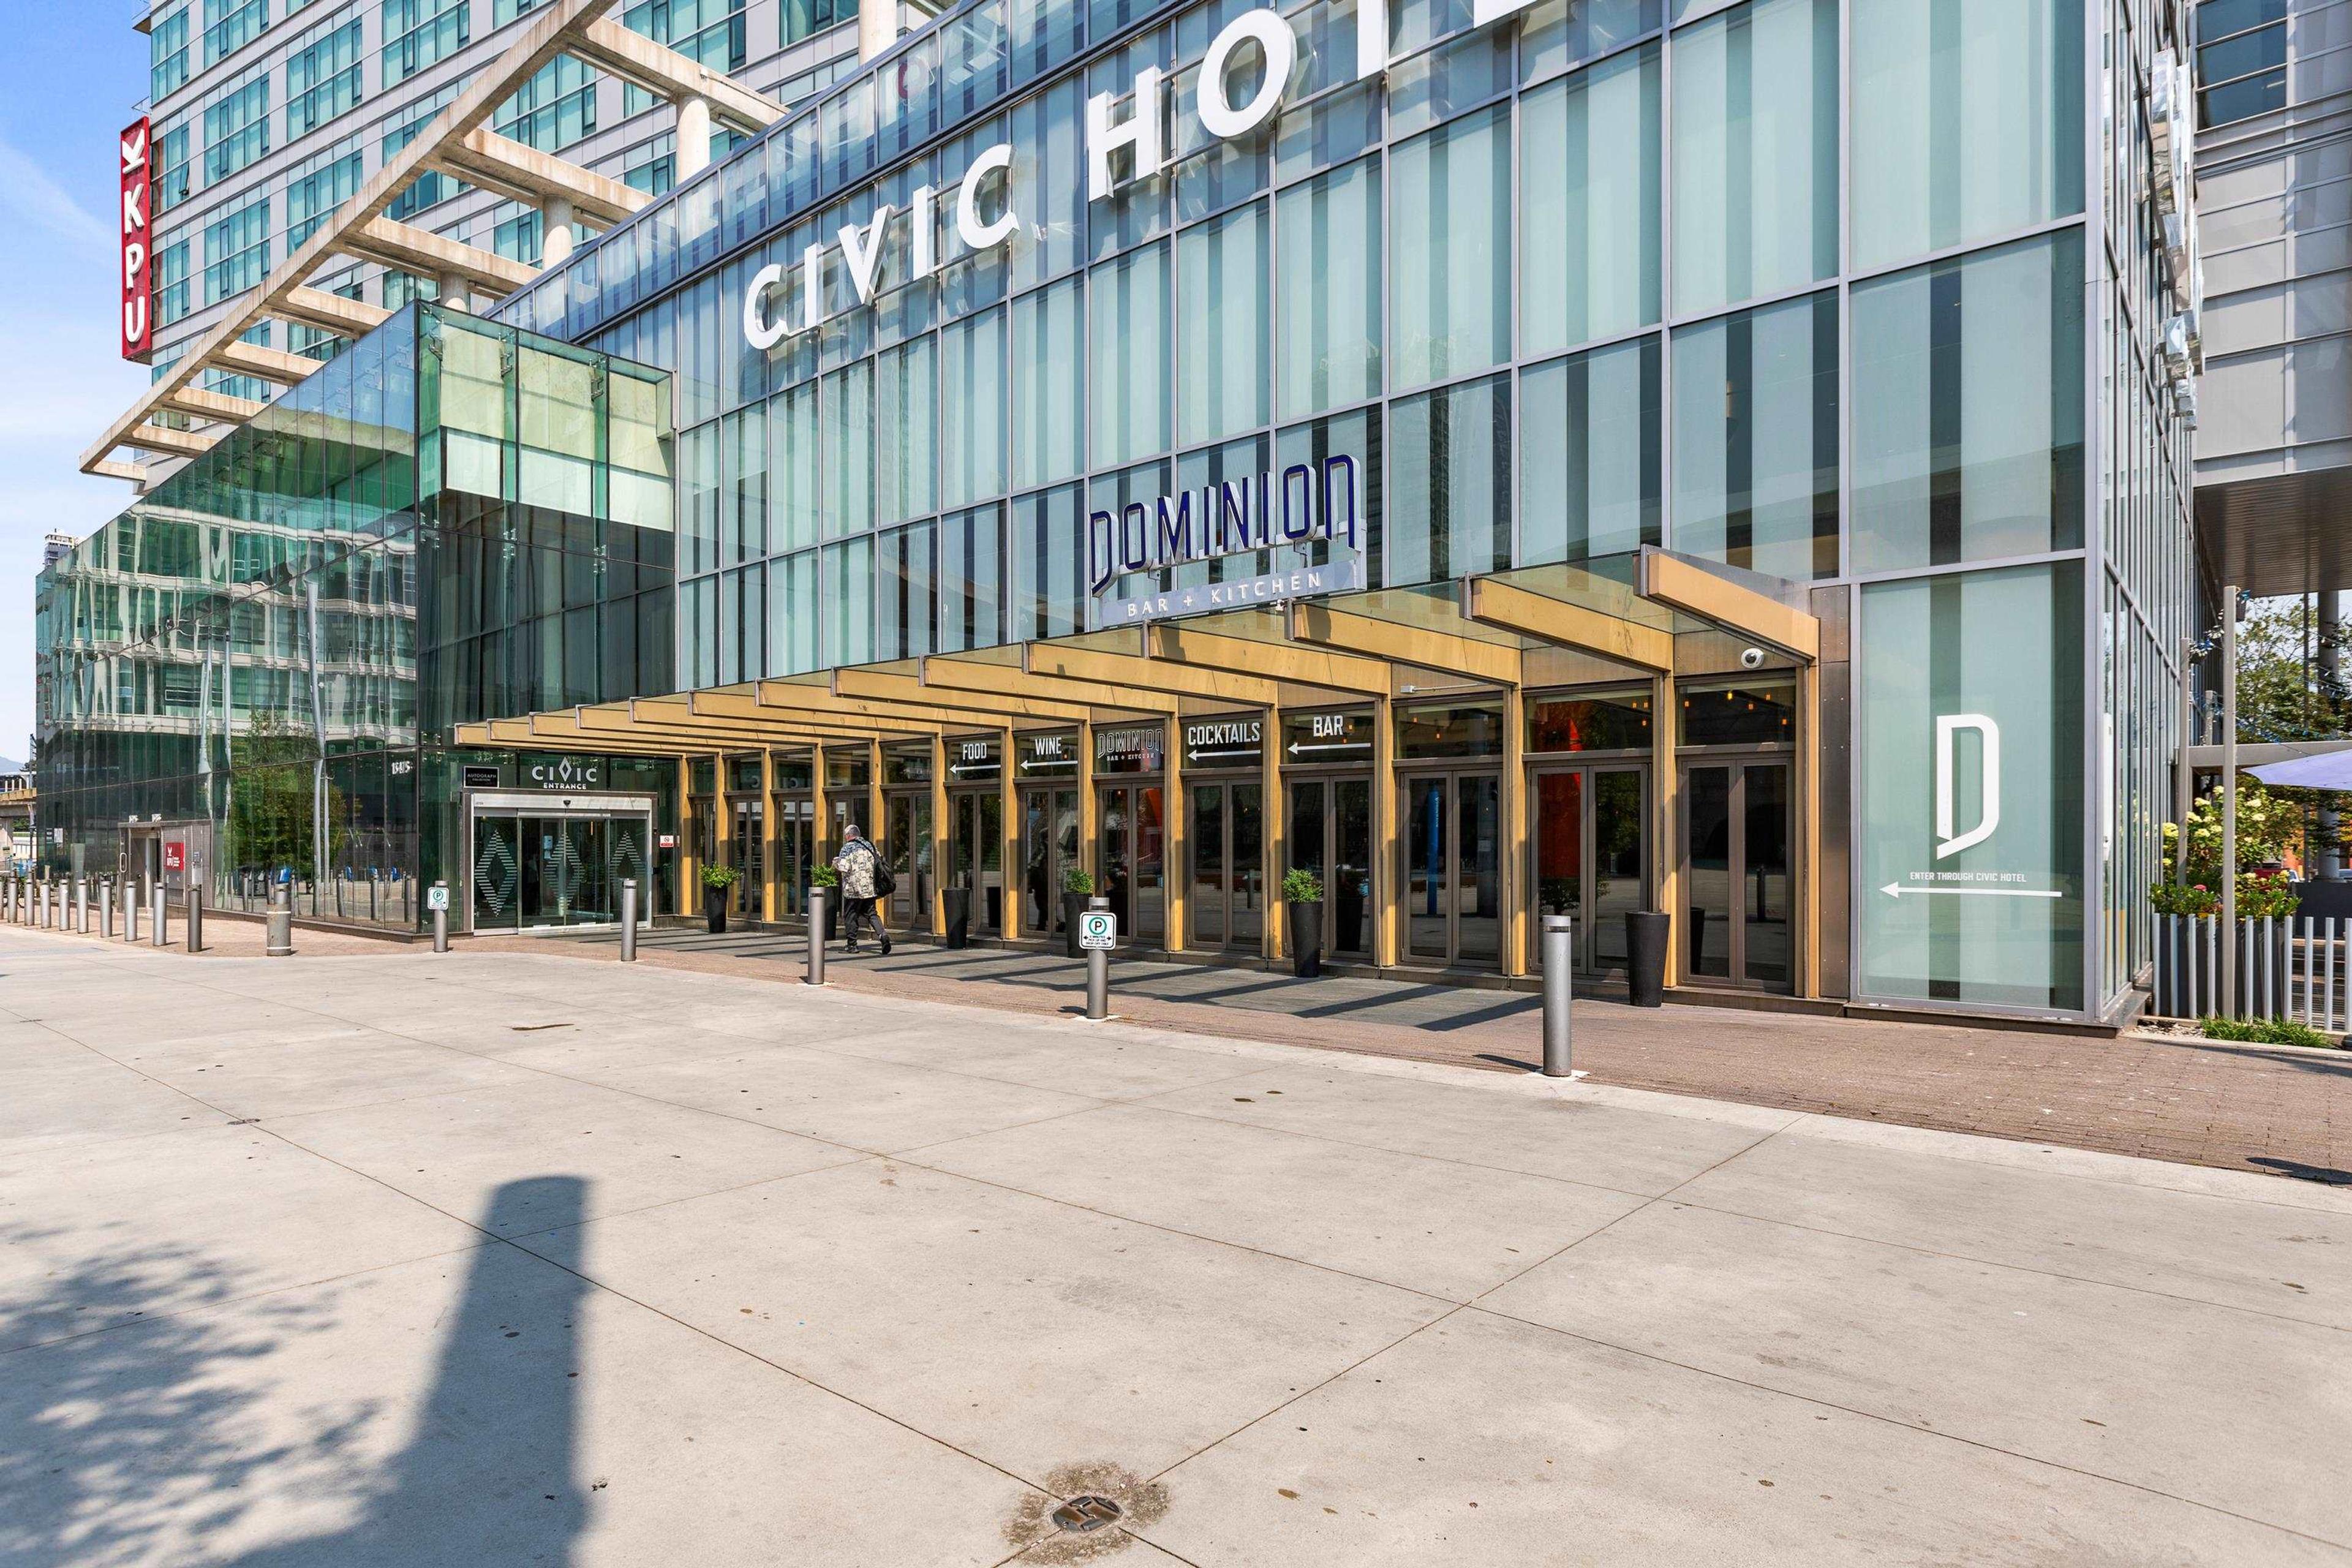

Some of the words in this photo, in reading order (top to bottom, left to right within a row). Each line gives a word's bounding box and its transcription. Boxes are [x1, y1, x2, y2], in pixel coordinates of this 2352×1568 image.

[744, 143, 1019, 351] CIVIC
[1089, 454, 1362, 598] DOMINION
[1127, 597, 1169, 617] BAR
[1211, 572, 1322, 604] KITCHEN
[1188, 722, 1261, 746] COCKTAILS
[1313, 715, 1344, 737] BAR
[962, 742, 987, 760] FOOD
[1035, 736, 1062, 755] WINE
[1098, 728, 1164, 759] DOMINION
[1936, 714, 2000, 860] D
[1910, 872, 1934, 881] ENTER
[1937, 872, 1974, 881] THROUGH
[1976, 872, 1998, 881] CIVIC
[2000, 873, 2027, 883] HOTEL
[1095, 921, 1102, 931] P
